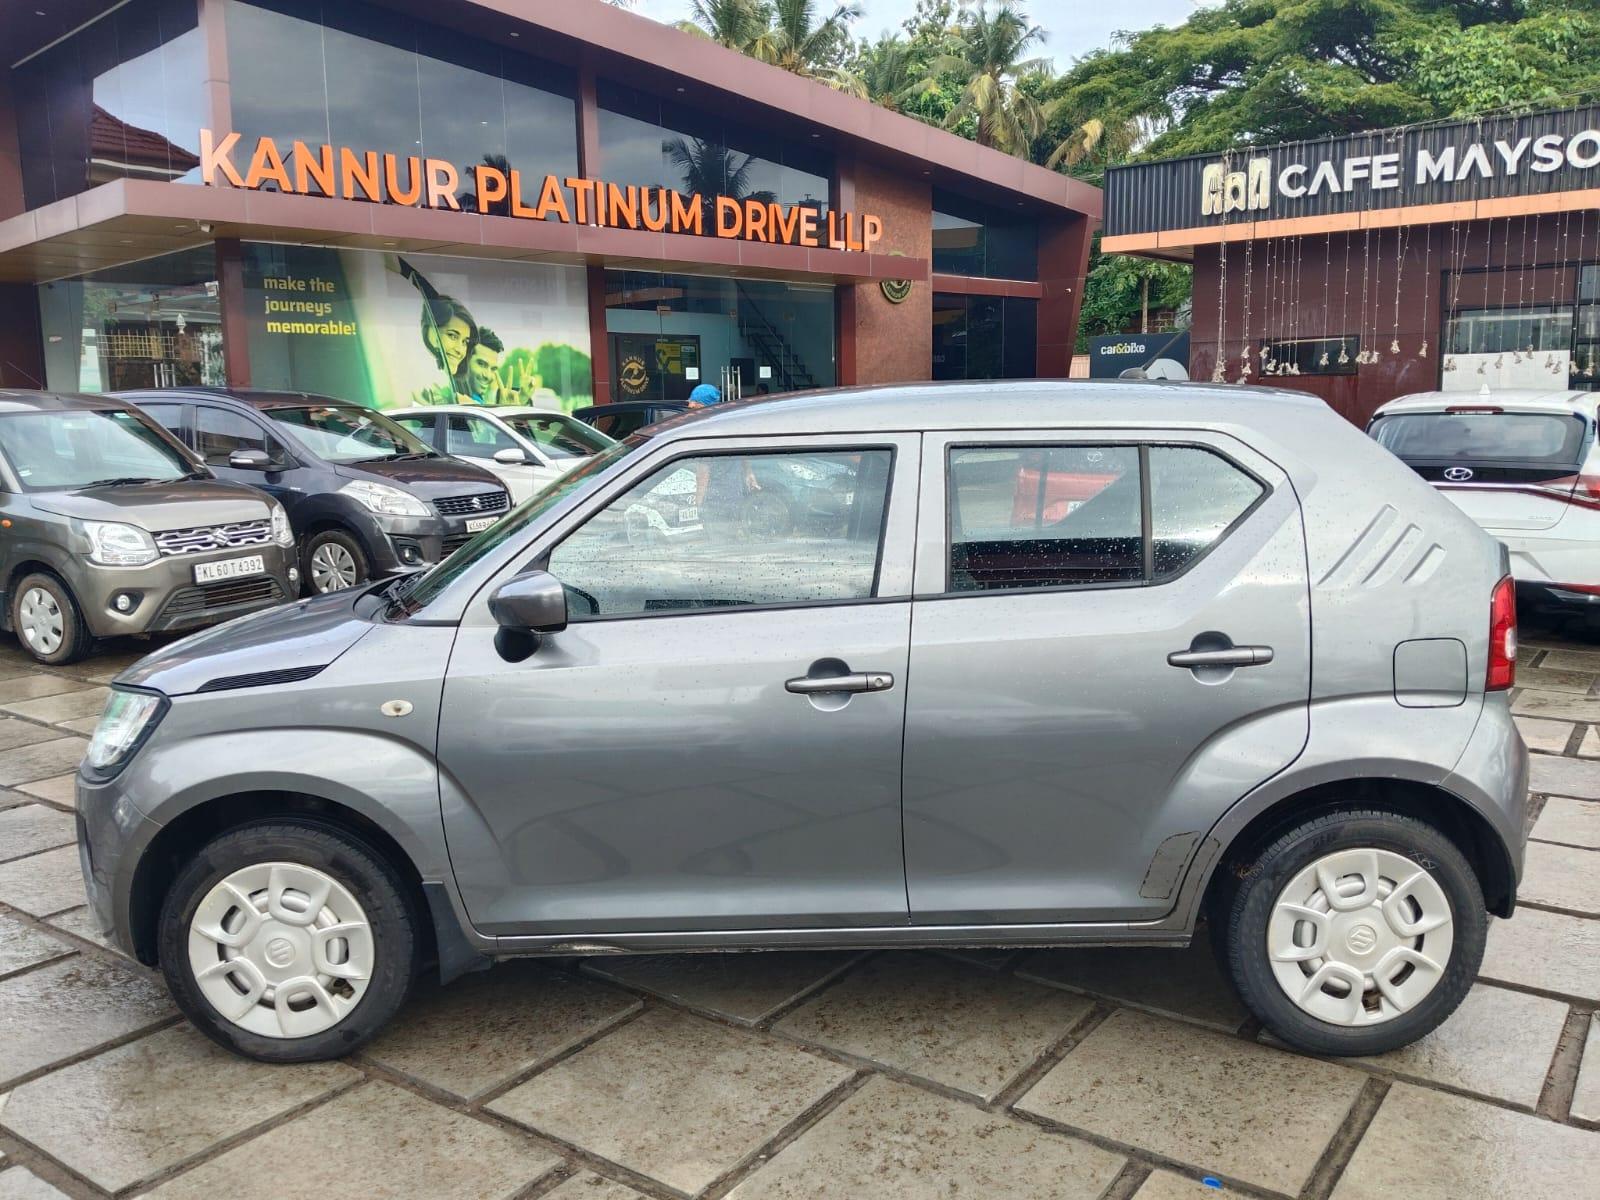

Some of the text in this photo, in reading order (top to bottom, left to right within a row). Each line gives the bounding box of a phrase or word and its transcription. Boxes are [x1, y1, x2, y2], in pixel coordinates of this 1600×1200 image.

[1278, 152, 1400, 199] CAFE
[199, 128, 883, 254] KANNUR PLATINUM DRIVE LLP
[263, 276, 336, 293] make the
[264, 295, 333, 317] journeys
[266, 319, 357, 336] memorable!
[1100, 342, 1146, 355] car&bike
